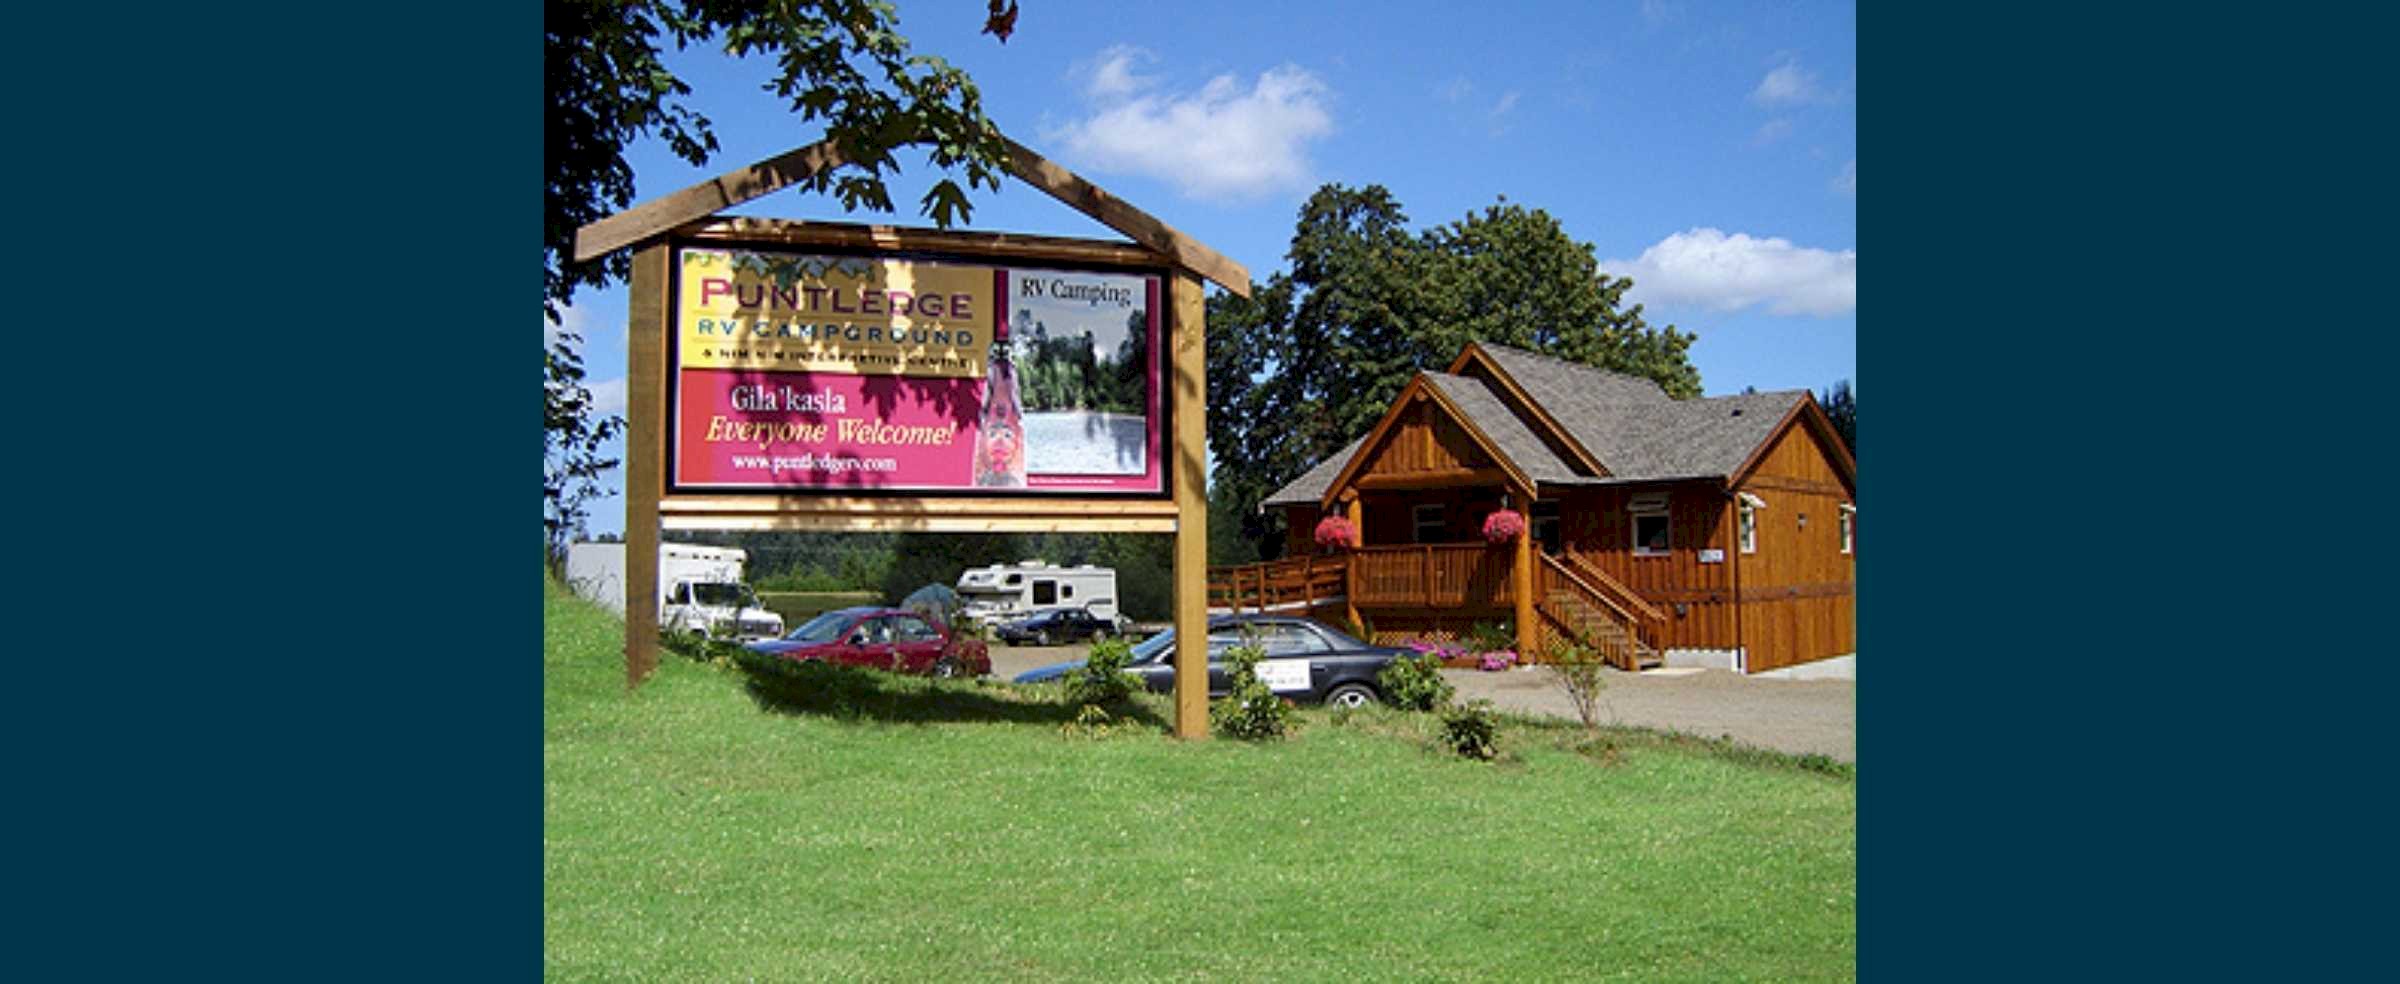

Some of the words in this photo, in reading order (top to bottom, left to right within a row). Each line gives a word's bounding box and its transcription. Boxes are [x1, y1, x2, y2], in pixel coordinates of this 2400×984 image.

[1021, 277, 1047, 298] RV
[1051, 278, 1131, 307] Camping
[698, 319, 737, 336] RV
[754, 321, 974, 346] CAMPGROUND
[731, 385, 846, 413] Gila'kasla
[705, 415, 828, 449] Everyone
[837, 418, 957, 445] Welcome!
